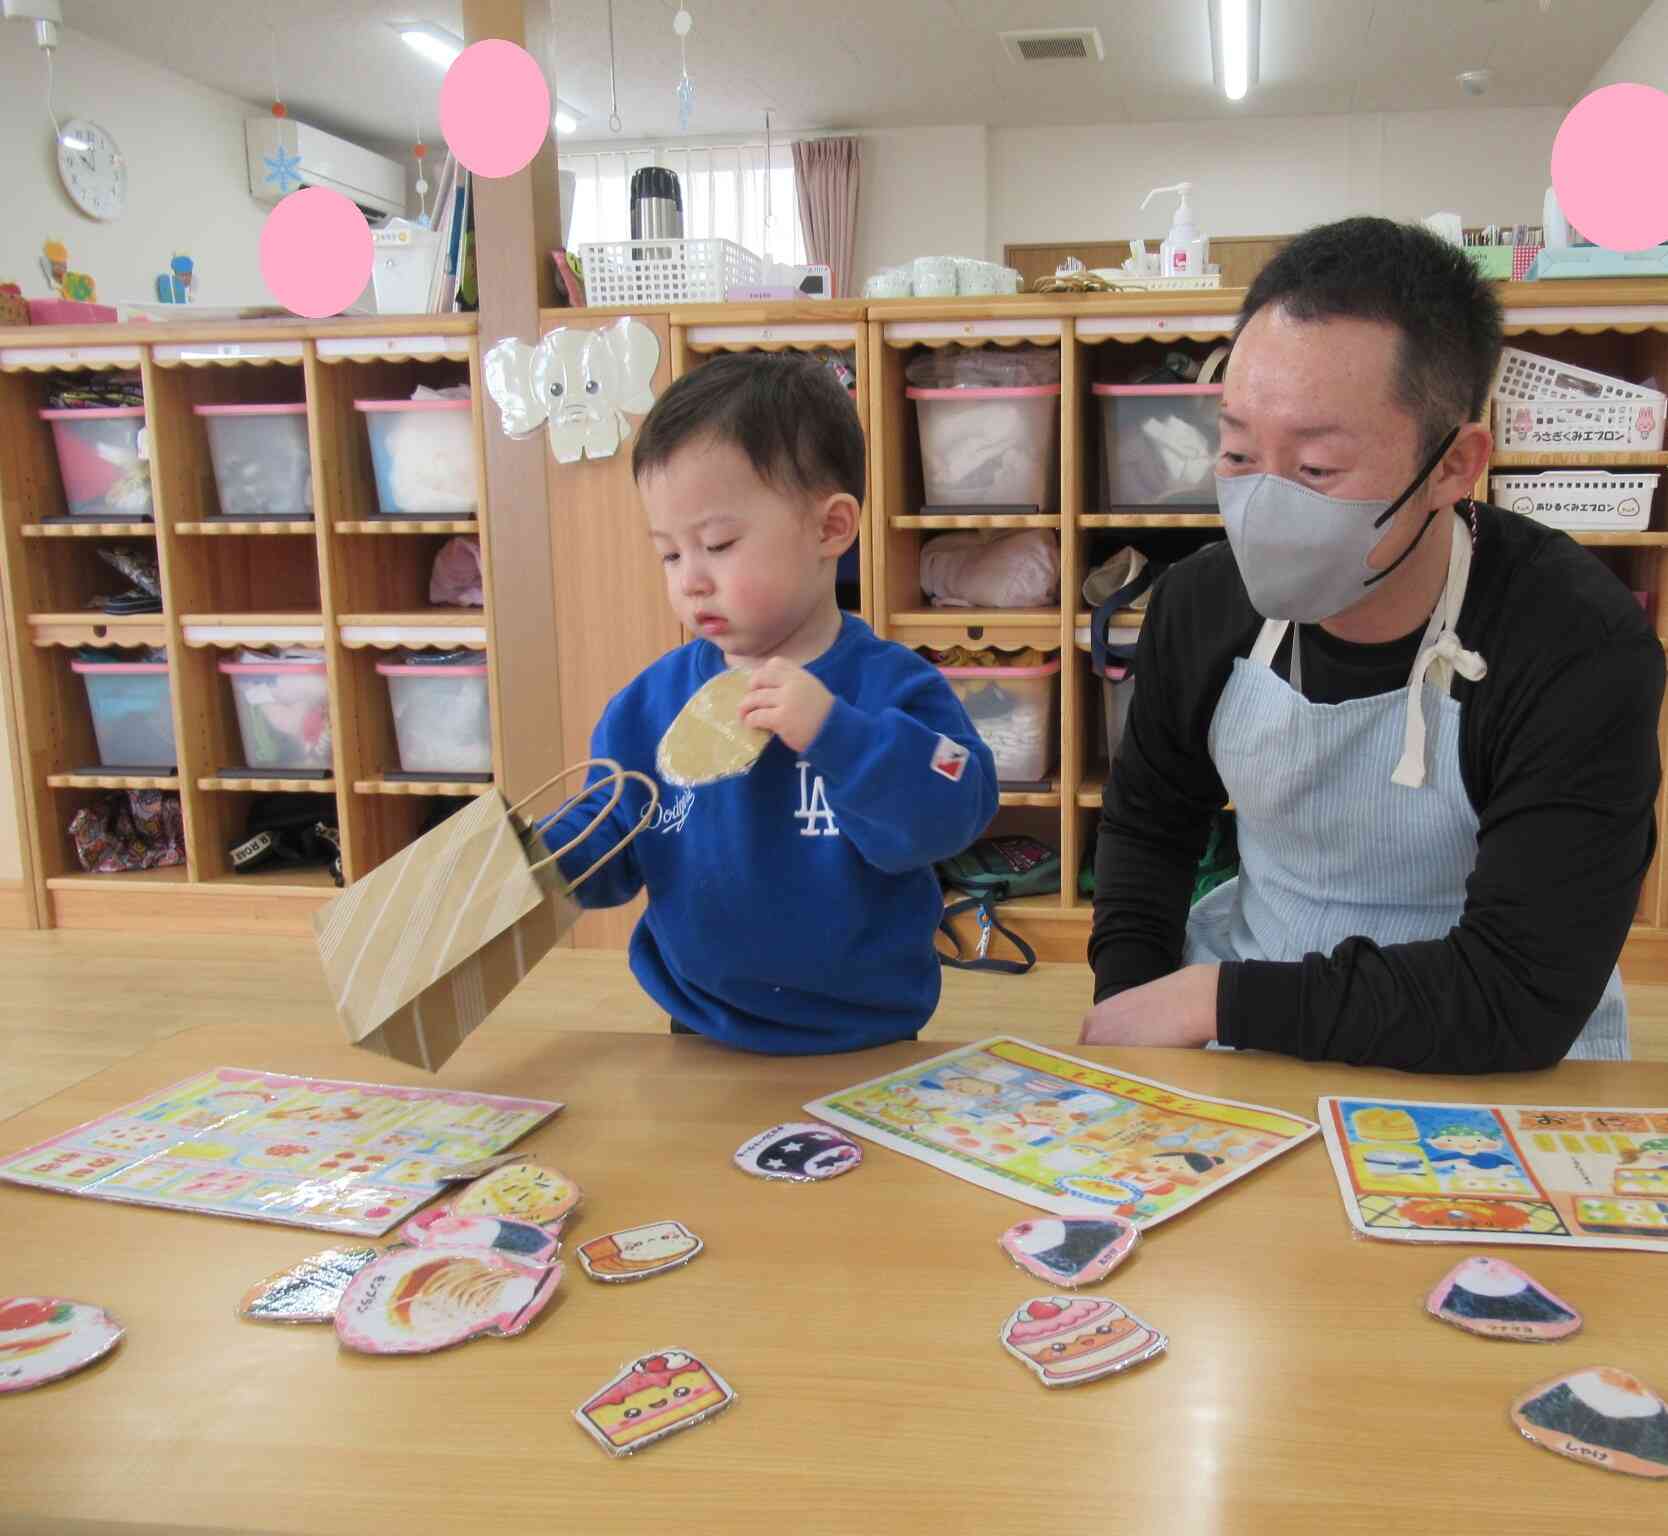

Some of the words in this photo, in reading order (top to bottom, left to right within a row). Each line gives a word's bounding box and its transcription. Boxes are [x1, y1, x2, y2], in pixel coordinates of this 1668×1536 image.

[1531, 429, 1625, 442] うさぎくみエプロン
[1535, 502, 1616, 513] あひるくみエプロン
[793, 760, 840, 837] LA
